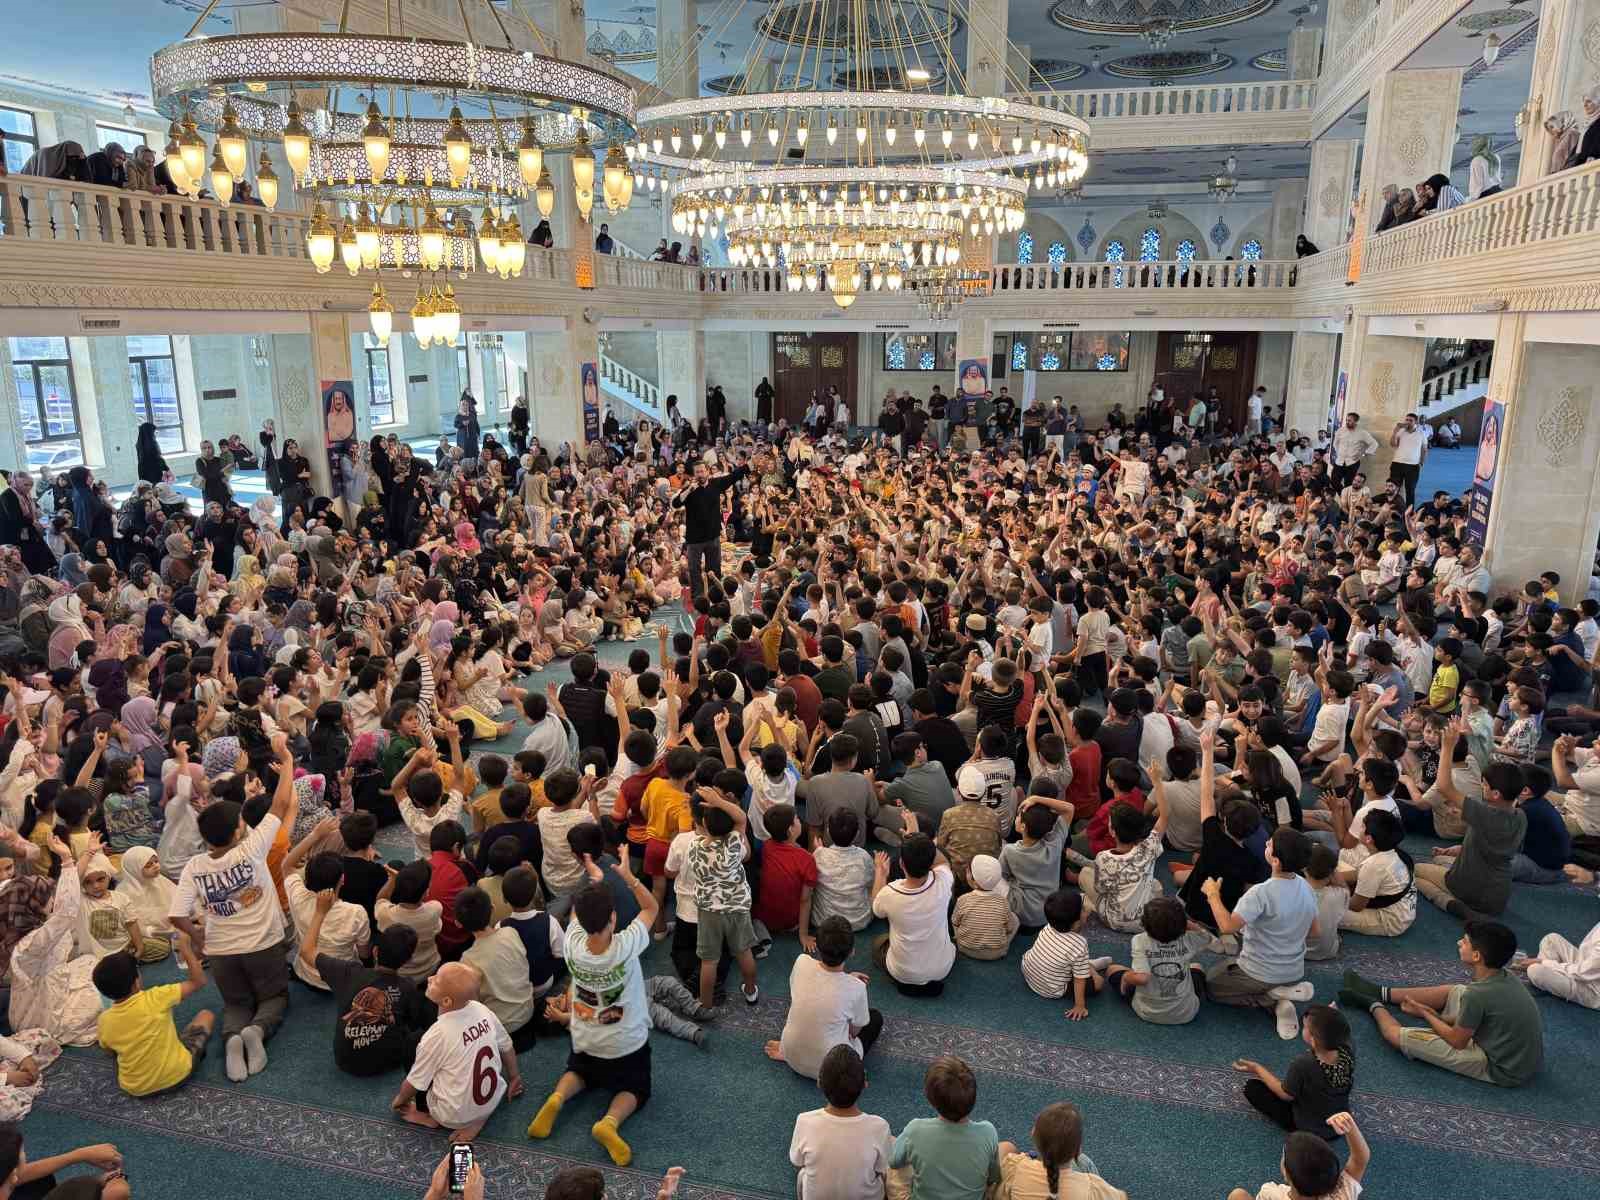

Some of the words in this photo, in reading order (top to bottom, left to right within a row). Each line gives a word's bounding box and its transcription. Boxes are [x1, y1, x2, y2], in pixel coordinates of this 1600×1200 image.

[986, 783, 1002, 809] 5
[462, 1018, 491, 1046] ADAR
[472, 1045, 498, 1106] 6
